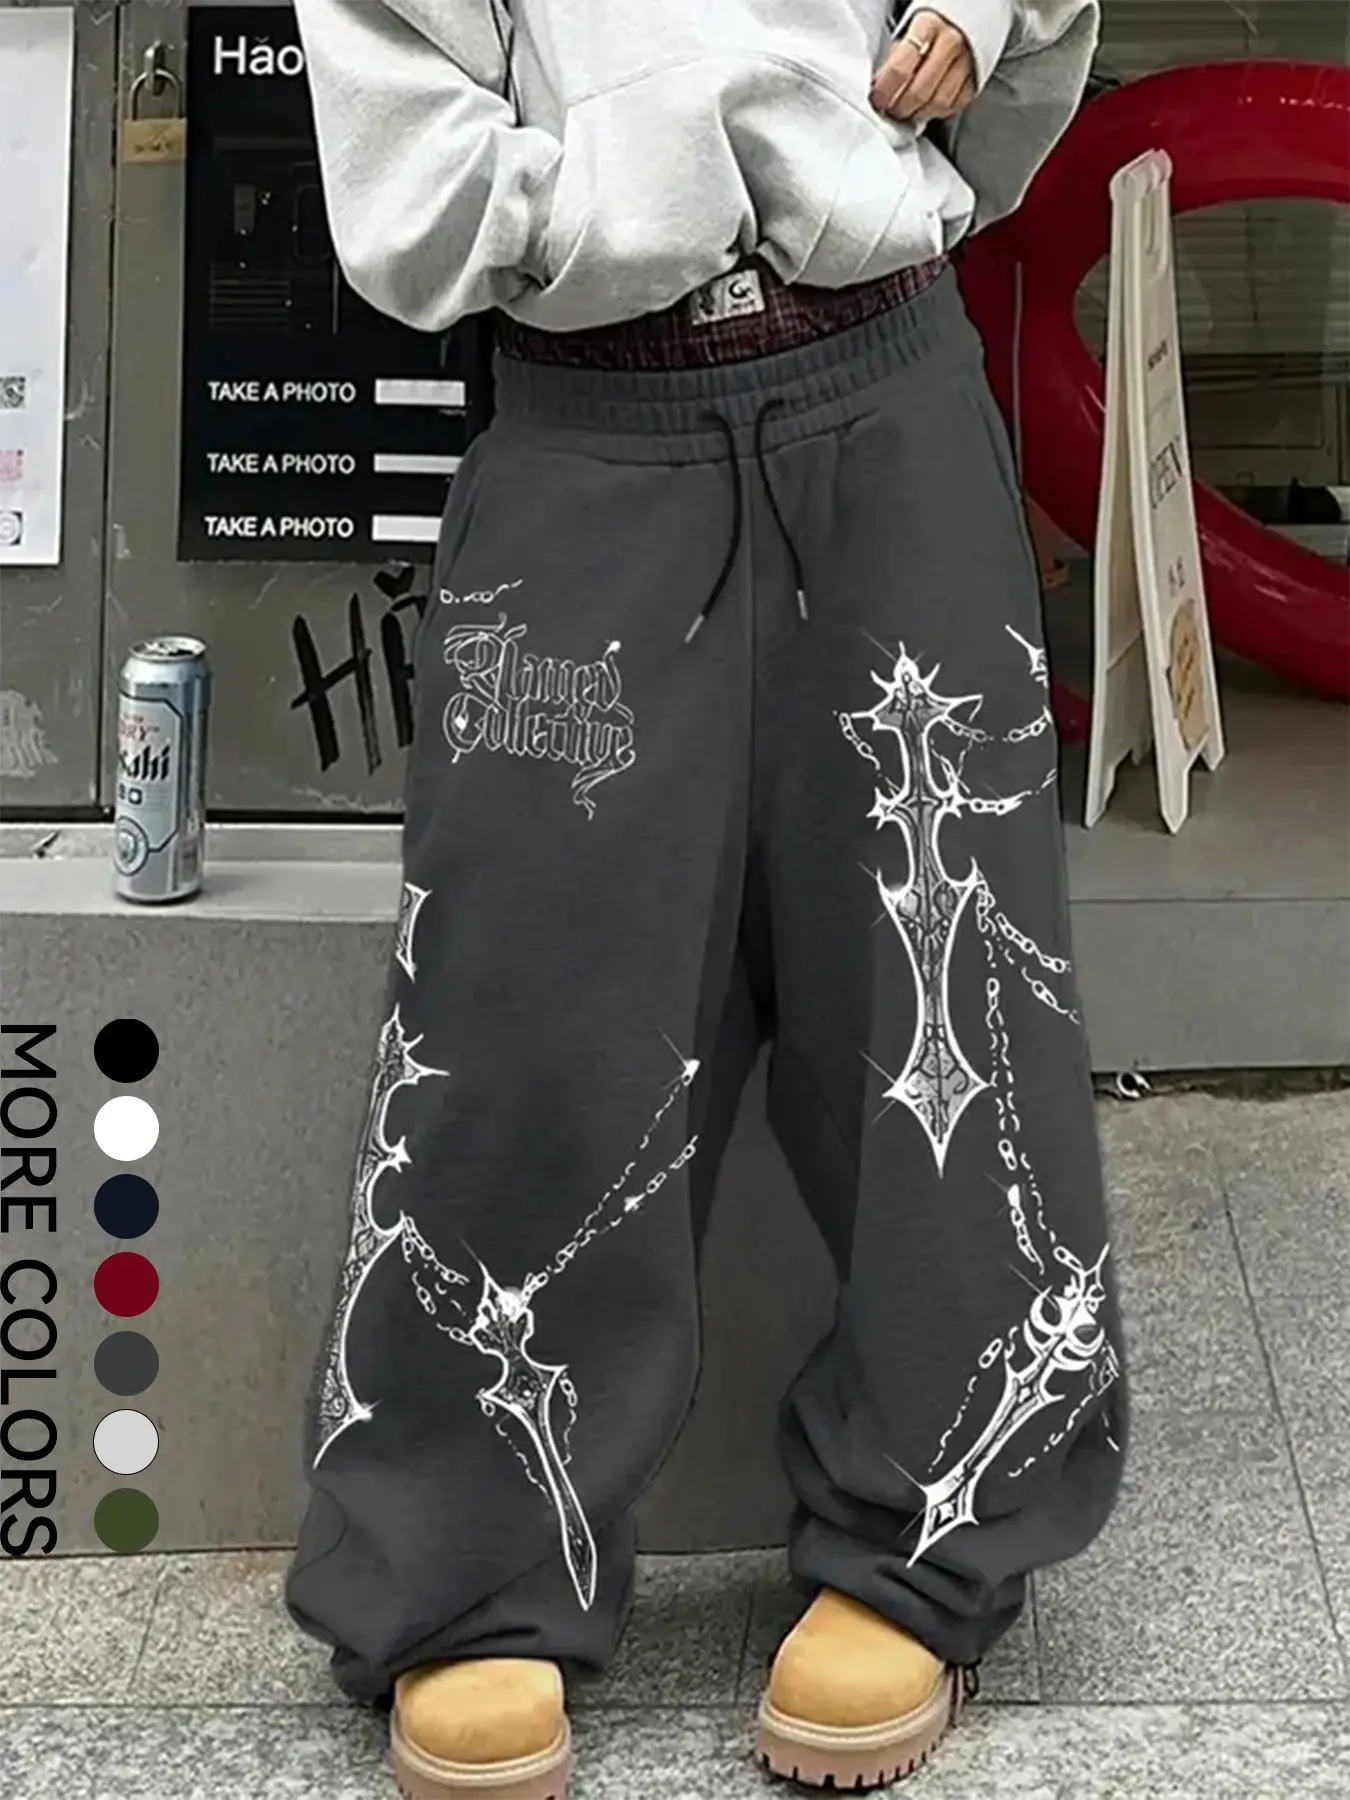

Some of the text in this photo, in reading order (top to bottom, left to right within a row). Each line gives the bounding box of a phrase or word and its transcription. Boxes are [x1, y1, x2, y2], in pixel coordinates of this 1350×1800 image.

[208, 381, 356, 403] TAKE A PHOTO
[207, 453, 356, 475] TAKE A PHOTO
[204, 516, 354, 538] TAKE A PHOTO
